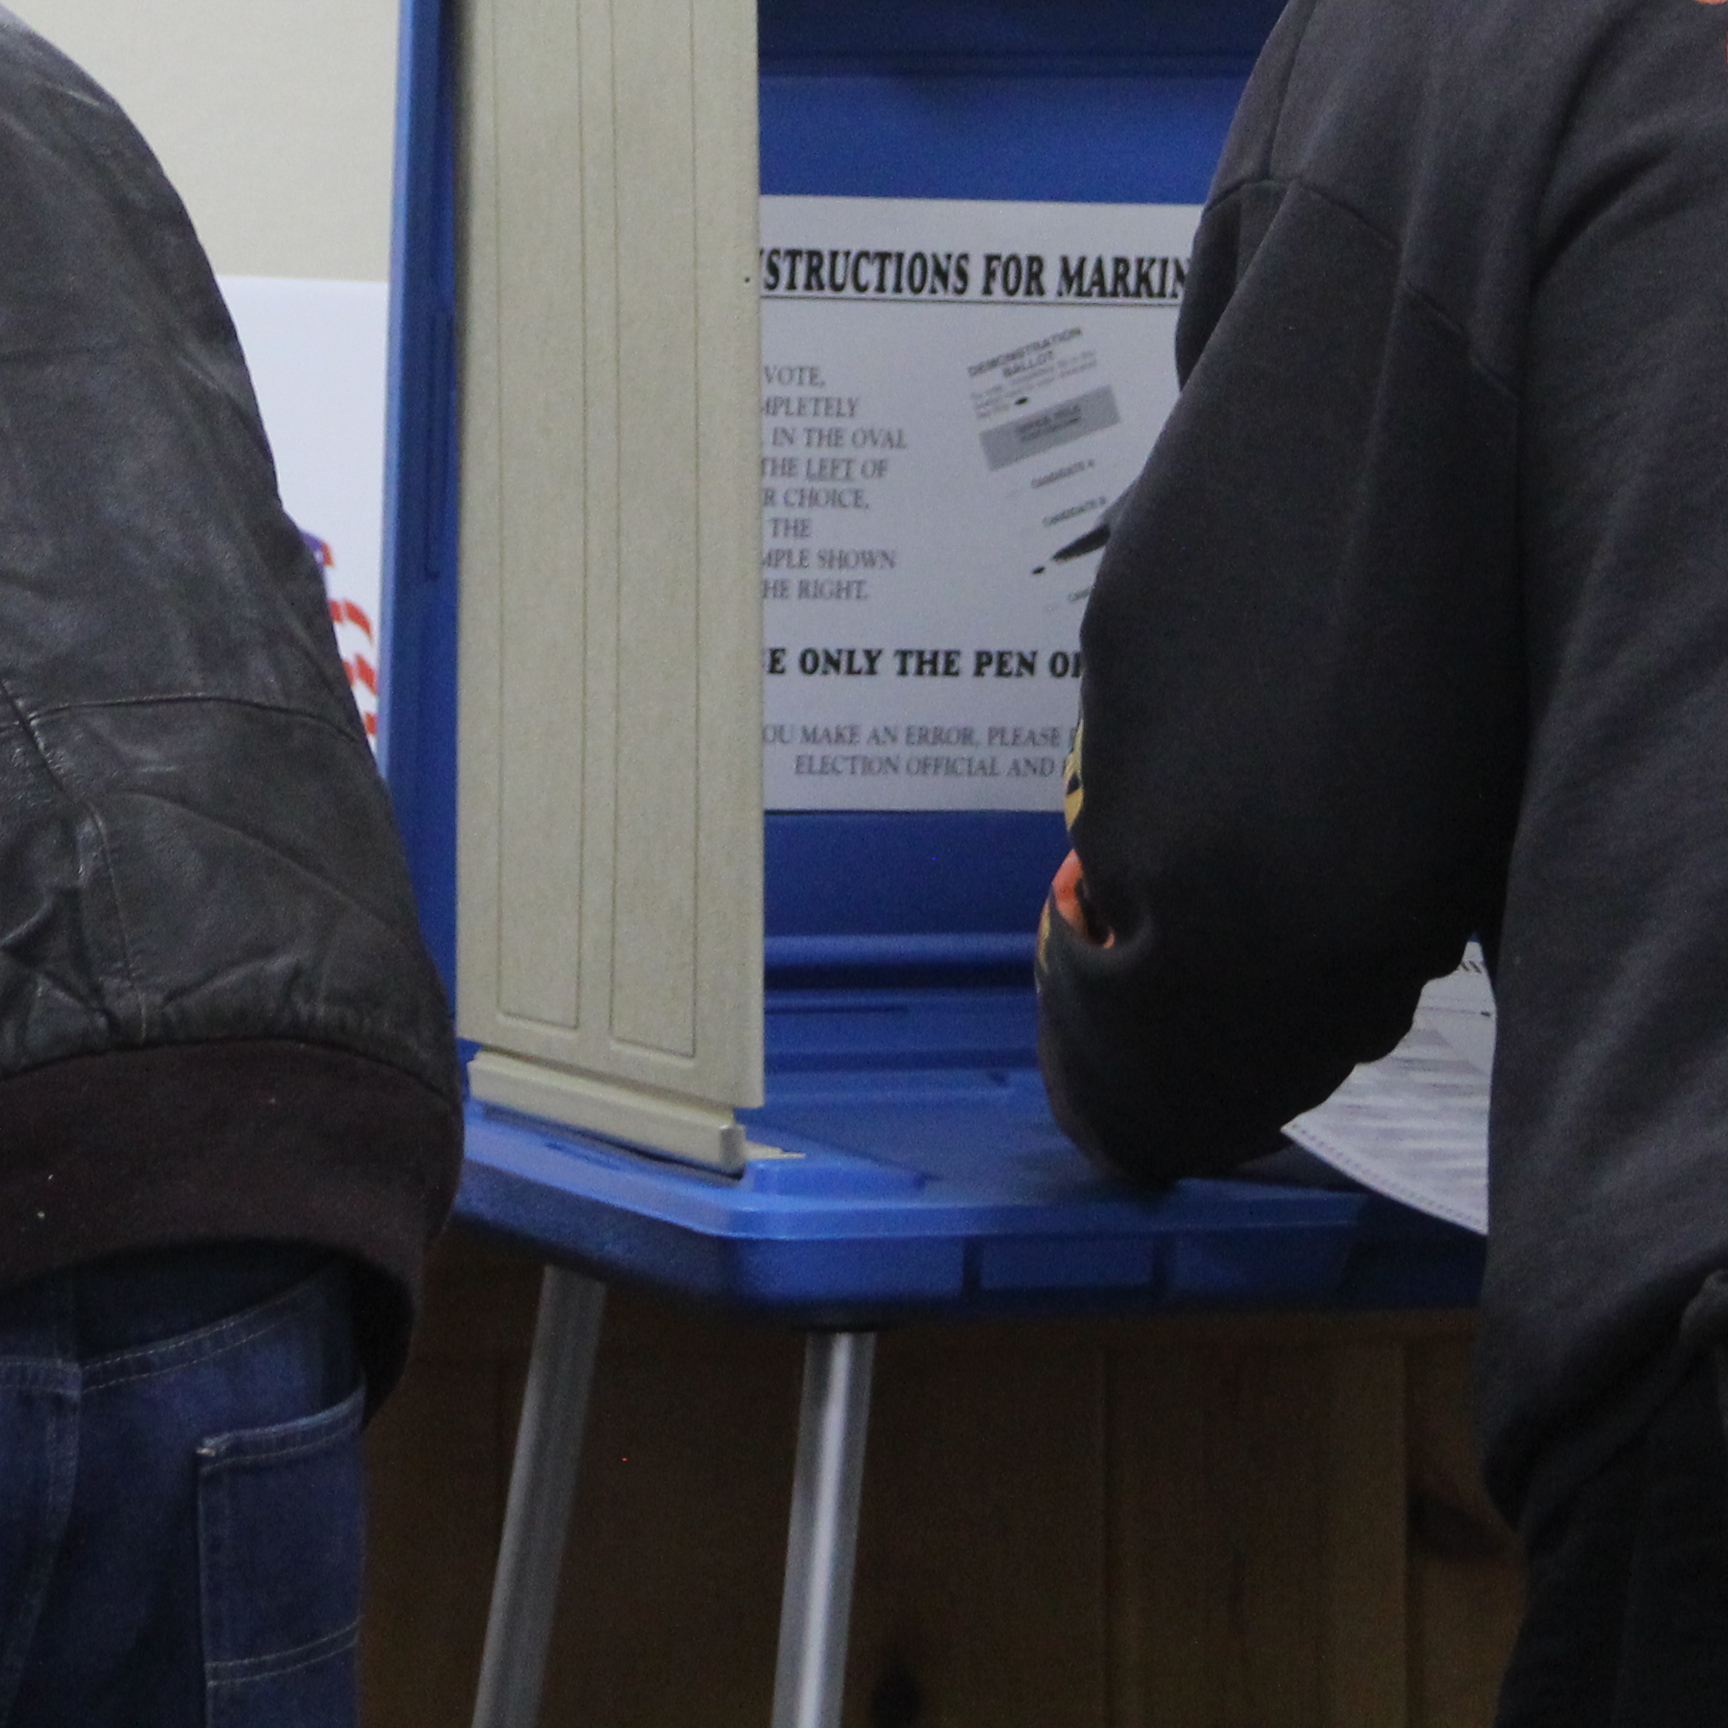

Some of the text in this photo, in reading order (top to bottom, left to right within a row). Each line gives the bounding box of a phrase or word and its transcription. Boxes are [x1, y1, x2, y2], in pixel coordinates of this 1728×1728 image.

[759, 247, 971, 296] STRUCTIONS
[981, 252, 1047, 298] FOR
[773, 426, 908, 450] IN THE OVAL
[806, 457, 857, 483] LEFT
[861, 458, 889, 480] OF
[771, 517, 812, 539] THE
[817, 548, 898, 570] SHOWN
[798, 648, 884, 676] ONLY
[894, 649, 962, 677] THE
[972, 650, 1039, 678] PEN
[800, 726, 861, 748] MAKE
[867, 726, 899, 747] AN
[987, 727, 1060, 749] PLEASE
[794, 754, 900, 776] ELECTION
[905, 755, 1001, 777] OFFICIAL
[1009, 756, 1058, 777] AND
